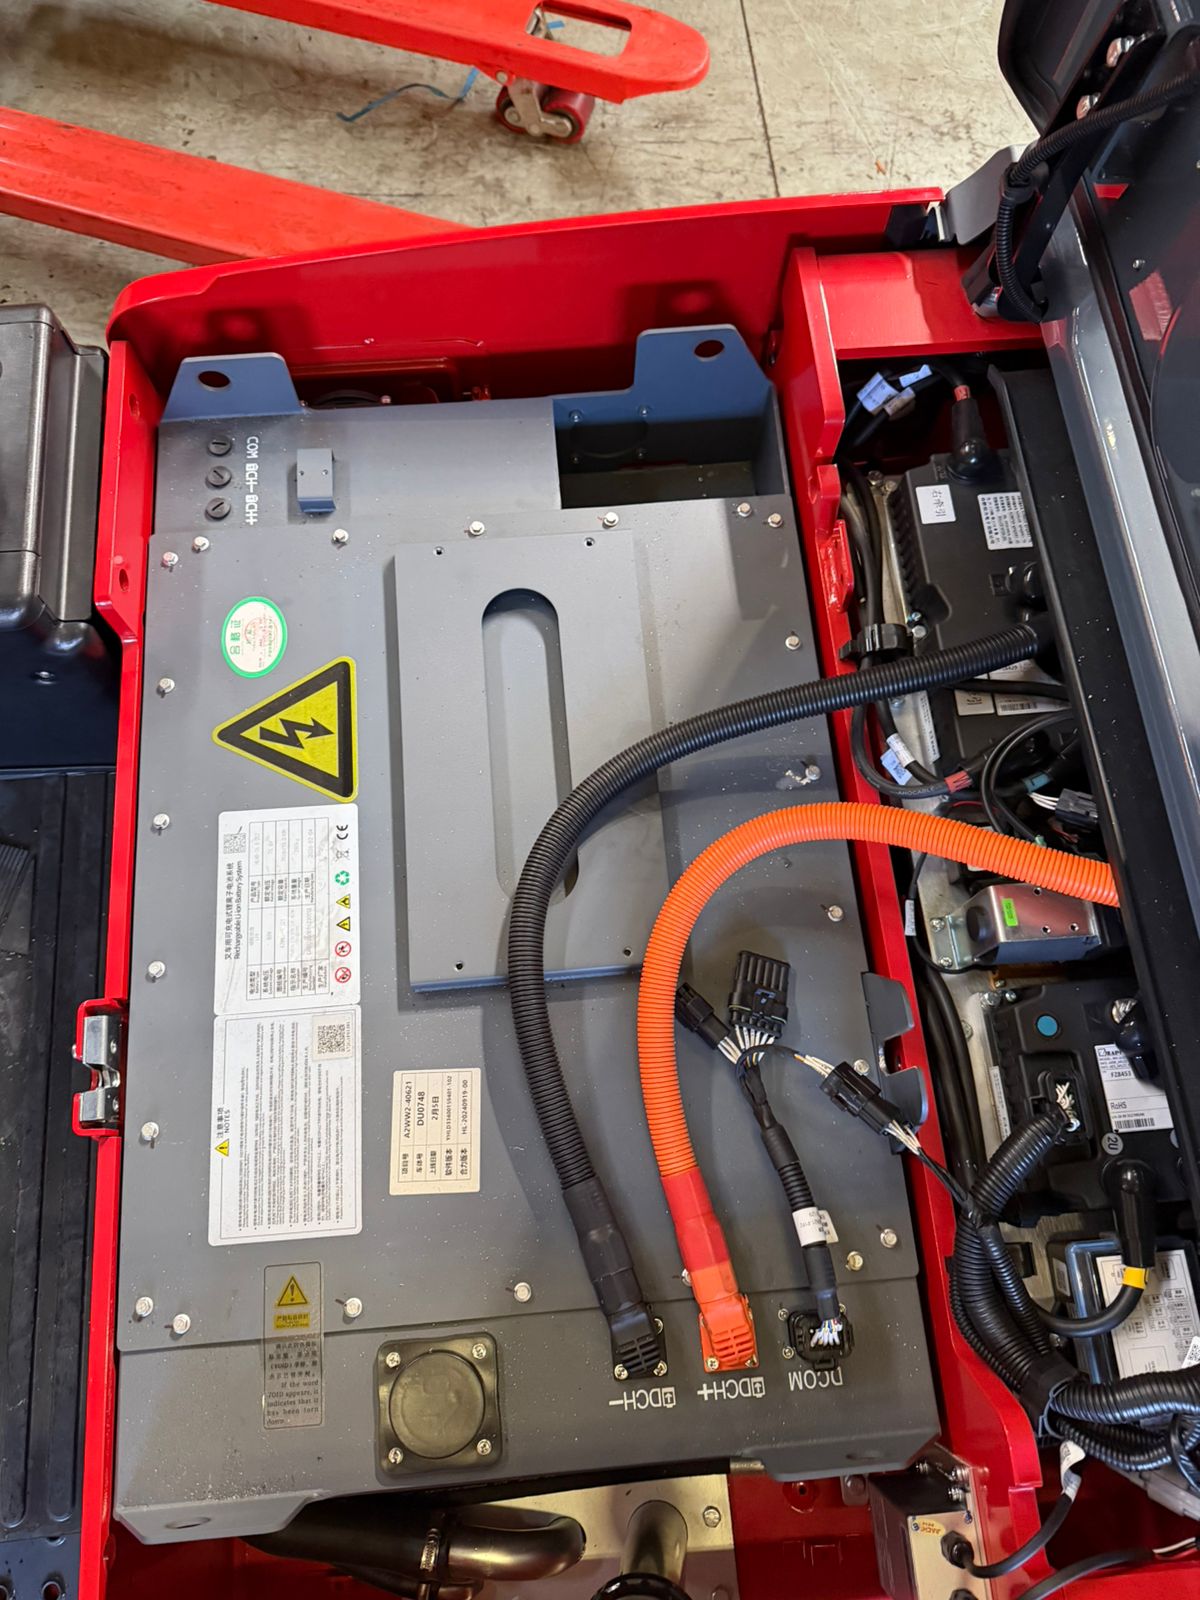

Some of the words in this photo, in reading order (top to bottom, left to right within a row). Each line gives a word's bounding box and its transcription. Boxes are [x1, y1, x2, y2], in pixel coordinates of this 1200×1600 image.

[246, 436, 258, 458] COM
[230, 619, 241, 655] 合格证
[235, 882, 243, 903] Battery
[224, 862, 234, 960] 叉车用可充电式锂离子电池系统
[234, 920, 242, 959] Rechargeable
[416, 1091, 425, 1126] DU0748
[431, 1096, 439, 1120] 2月5日
[1110, 1101, 1127, 1110] RoHS
[216, 1106, 224, 1138] 注意事项
[460, 1148, 468, 1175] 合力版本
[290, 1380, 300, 1388] the
[788, 1366, 843, 1391] DCOM
[267, 1398, 297, 1407] indicates
[283, 1407, 300, 1415] been
